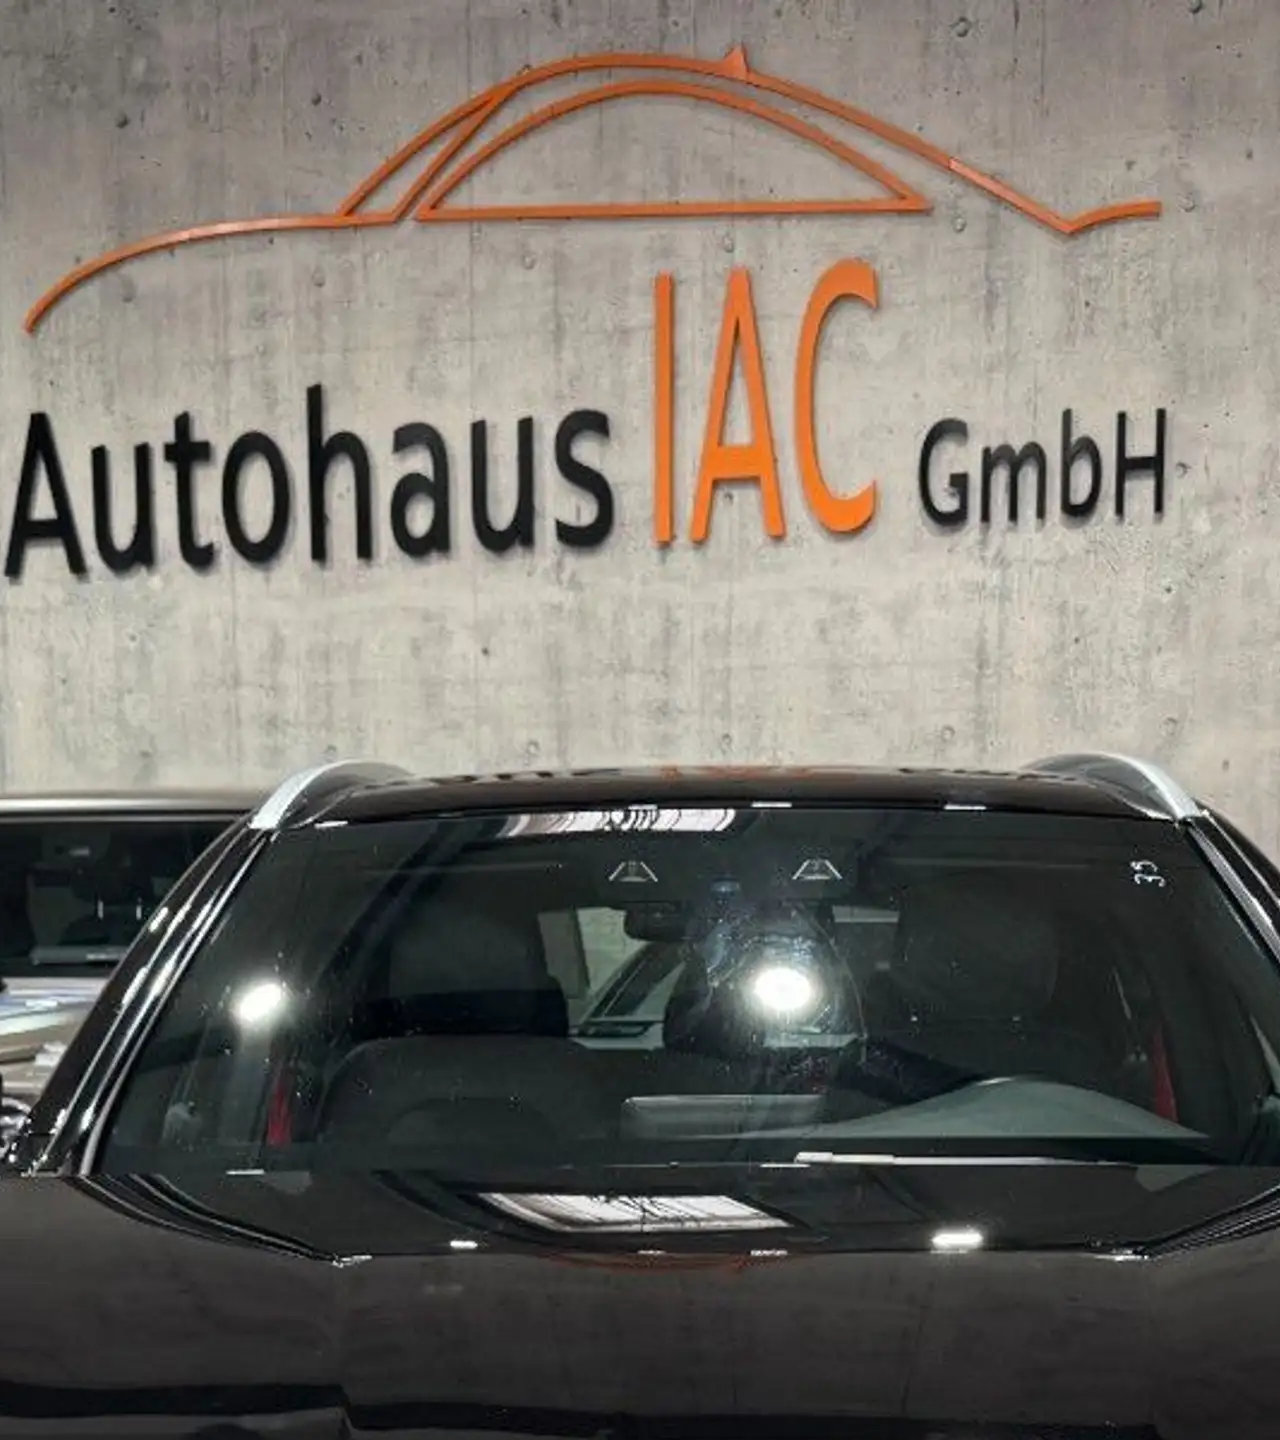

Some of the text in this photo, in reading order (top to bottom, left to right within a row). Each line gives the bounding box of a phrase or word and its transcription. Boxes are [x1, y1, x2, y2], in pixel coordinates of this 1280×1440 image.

[4, 257, 1167, 579] Autohaus IAC GmbH
